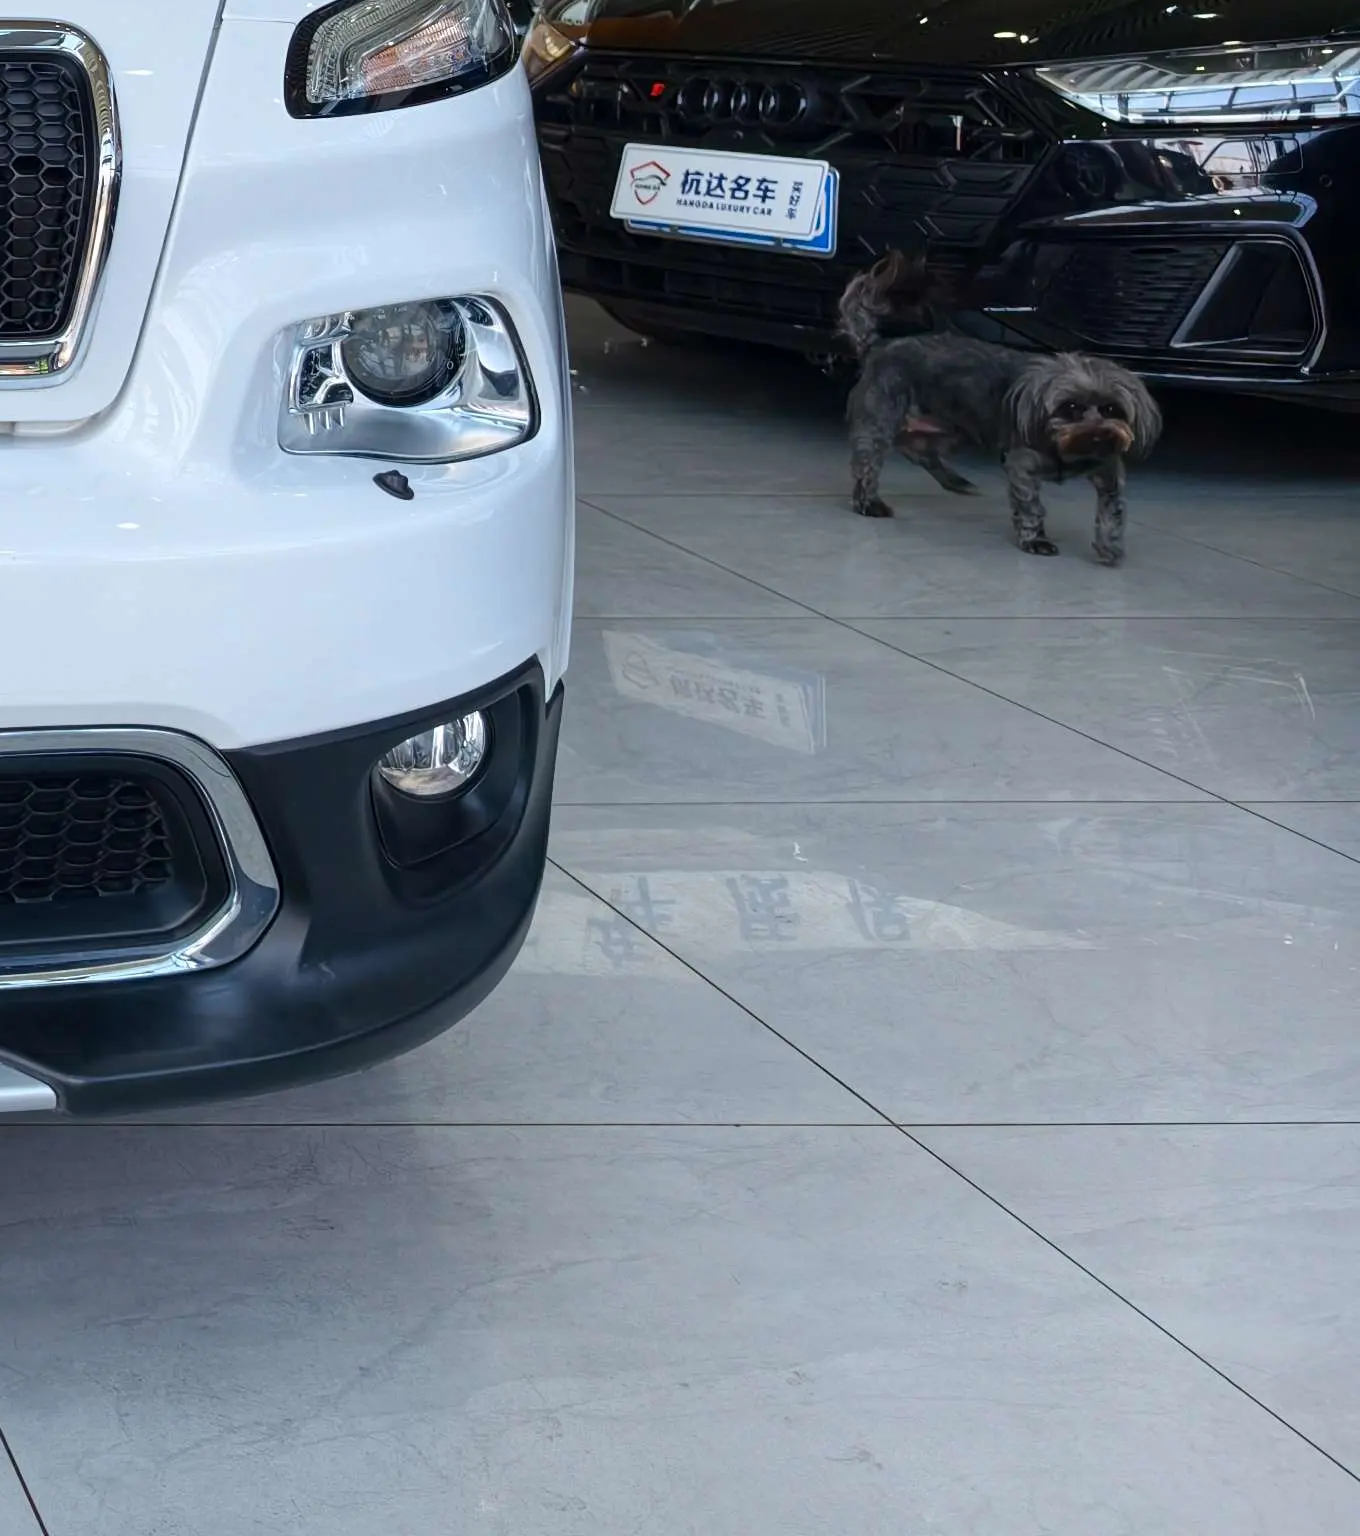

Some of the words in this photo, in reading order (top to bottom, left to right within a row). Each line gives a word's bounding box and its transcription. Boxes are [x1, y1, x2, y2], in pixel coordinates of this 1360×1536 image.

[680, 169, 779, 204] 杭达名车
[753, 205, 773, 217] CAR
